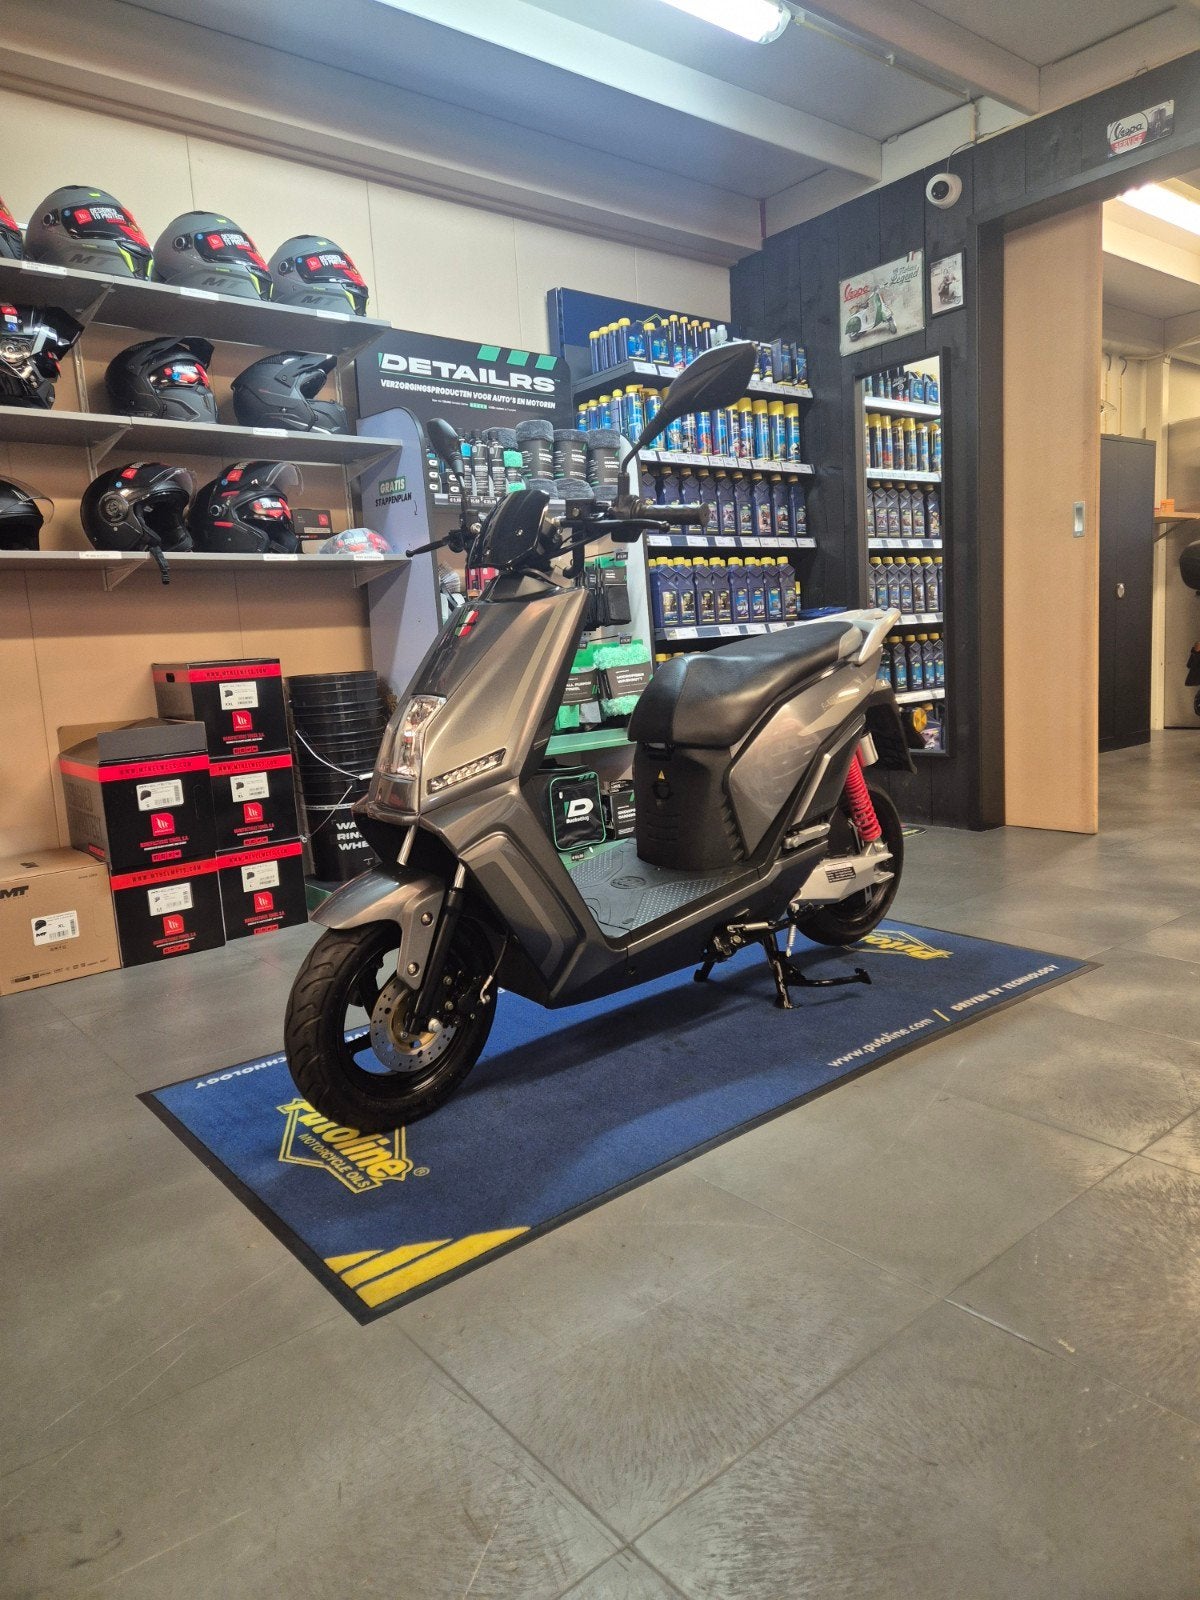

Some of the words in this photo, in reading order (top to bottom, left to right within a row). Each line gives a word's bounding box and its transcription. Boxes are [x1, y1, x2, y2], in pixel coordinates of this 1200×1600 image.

[380, 353, 555, 393] DETAILRS
[380, 379, 472, 399] VERZORGINGSPRODUCTEN
[473, 391, 492, 402] VOOR
[492, 394, 516, 404] AUTO'S
[517, 397, 526, 405] EN
[526, 398, 556, 409] MOTOREN
[380, 479, 405, 494] GRATIS
[375, 491, 412, 507] STAPPENPLAN
[336, 821, 357, 830] WA
[337, 831, 363, 840] RIN
[338, 840, 370, 850] WHE
[0, 885, 29, 899] MT
[827, 1018, 935, 1068] www.putoline.com
[950, 993, 991, 1012] DRIVEN
[988, 987, 1004, 997] BY
[1002, 964, 1060, 990] TECHNOLOGY
[195, 1056, 287, 1089] CHNOLOGY
[298, 1133, 349, 1173] MOTORCYCLE
[346, 1168, 371, 1188] OILS
